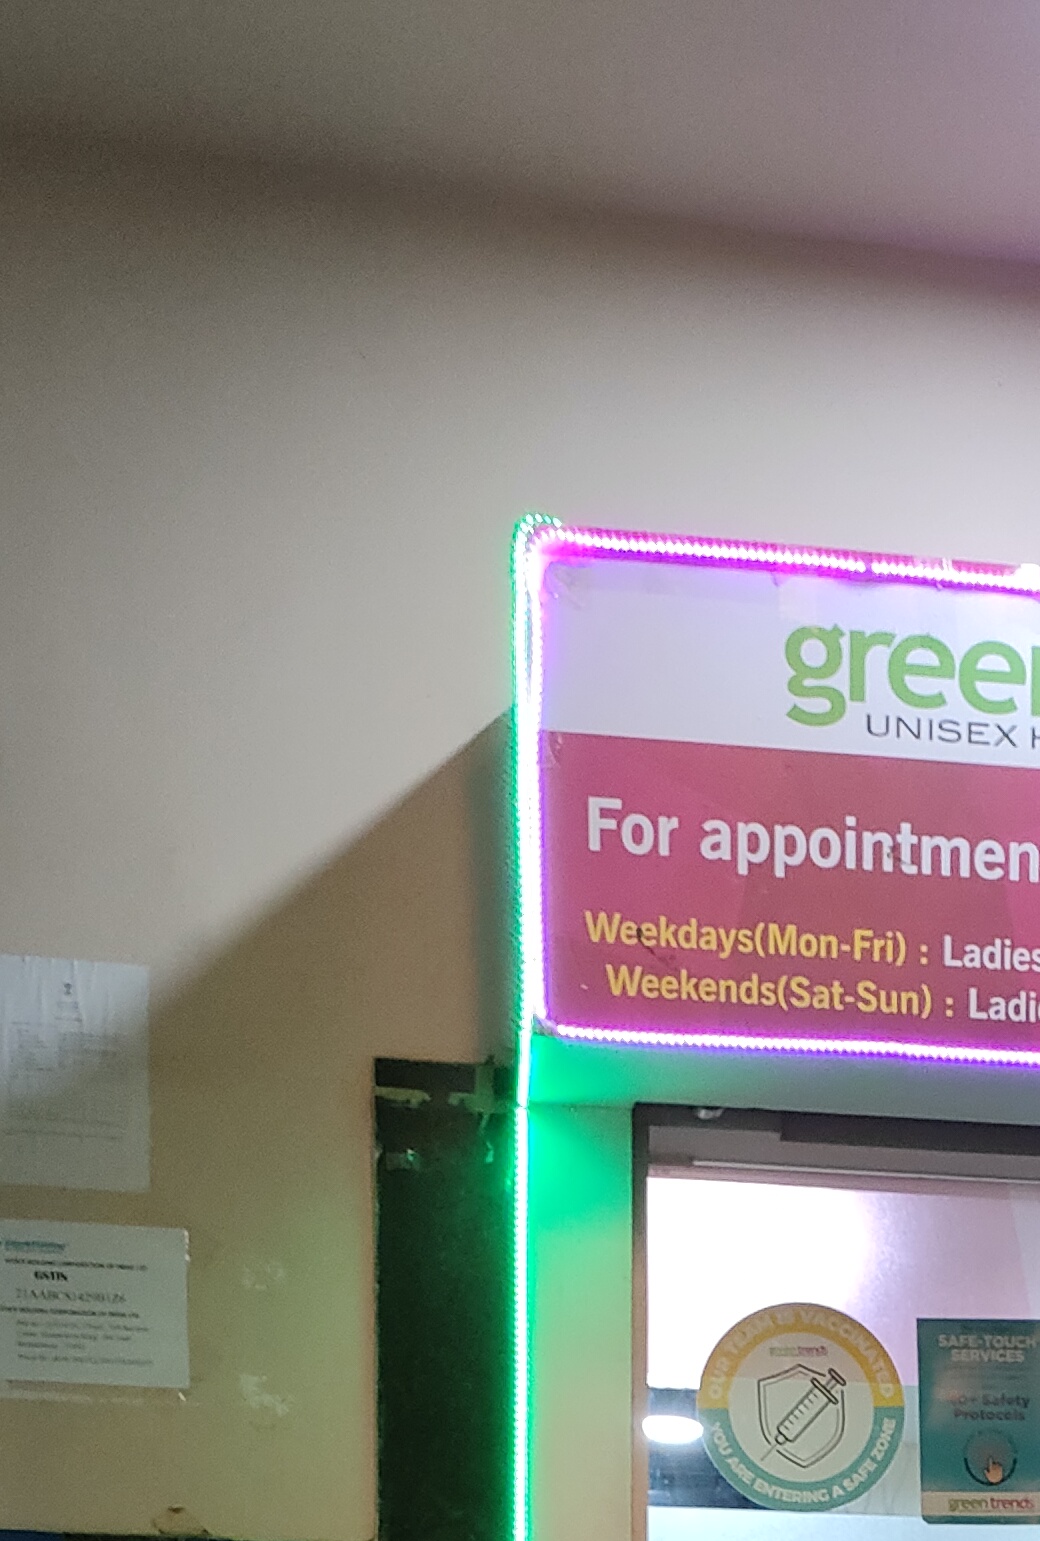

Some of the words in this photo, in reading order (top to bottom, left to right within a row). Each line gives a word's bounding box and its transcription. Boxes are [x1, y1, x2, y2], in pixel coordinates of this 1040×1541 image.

[866, 714, 1018, 748] UNISEX
[586, 796, 679, 857] For
[585, 910, 907, 966] Weekdays(Mon-Fri)
[605, 964, 932, 1019] Weekends(Sat-Sun)
[938, 1333, 1038, 1349] SAFE-TOUCH
[951, 1350, 1025, 1364] SERVICES
[948, 1497, 989, 1513] green
[990, 1496, 1035, 1510] trends
